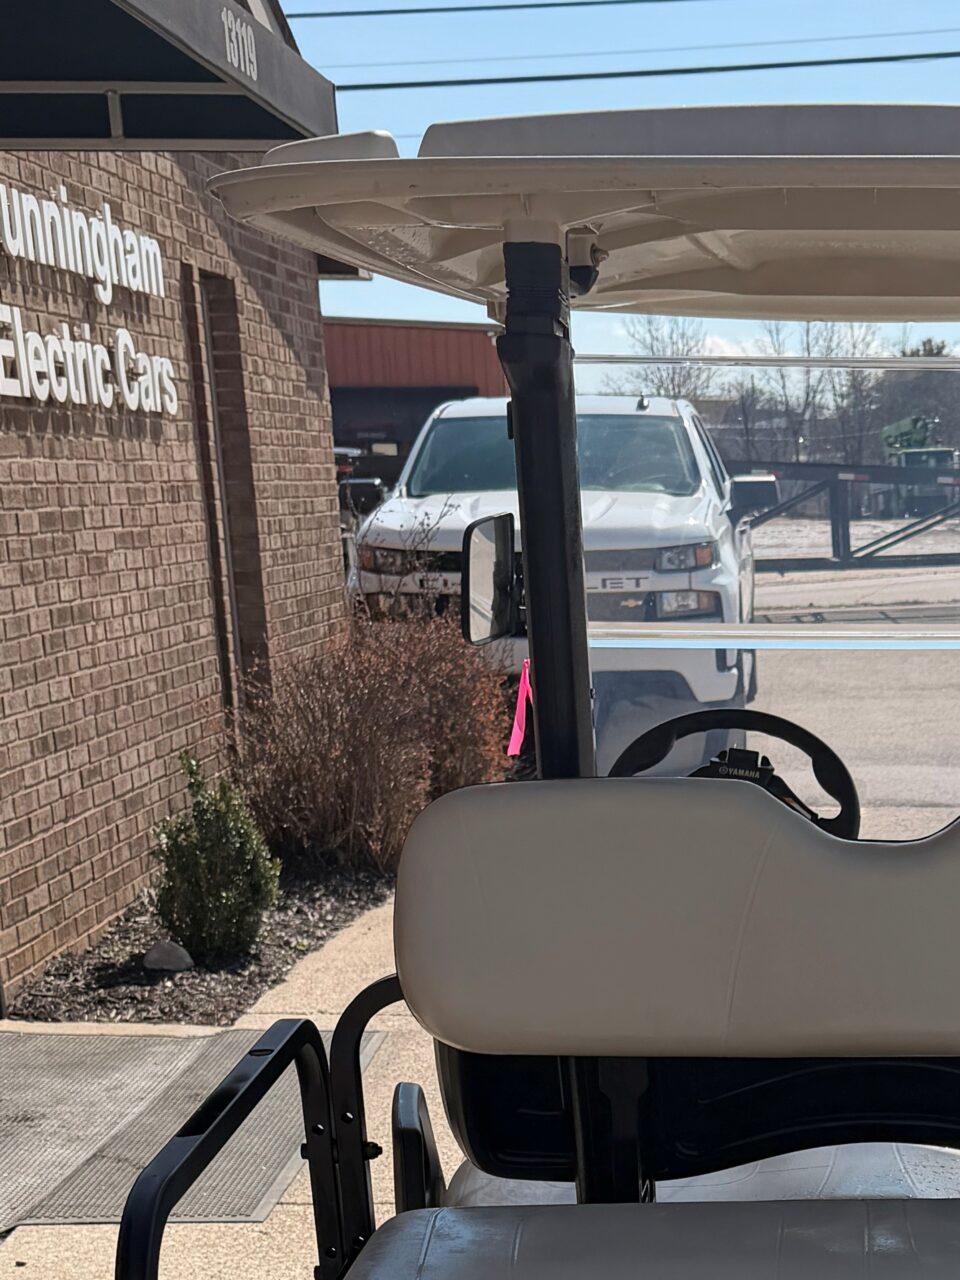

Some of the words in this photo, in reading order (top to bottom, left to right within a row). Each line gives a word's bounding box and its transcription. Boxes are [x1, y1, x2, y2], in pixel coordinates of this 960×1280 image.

[221, 6, 257, 81] 13119
[0, 303, 113, 409] Electric
[115, 328, 178, 416] Cars
[728, 767, 760, 779] YAMAHA
